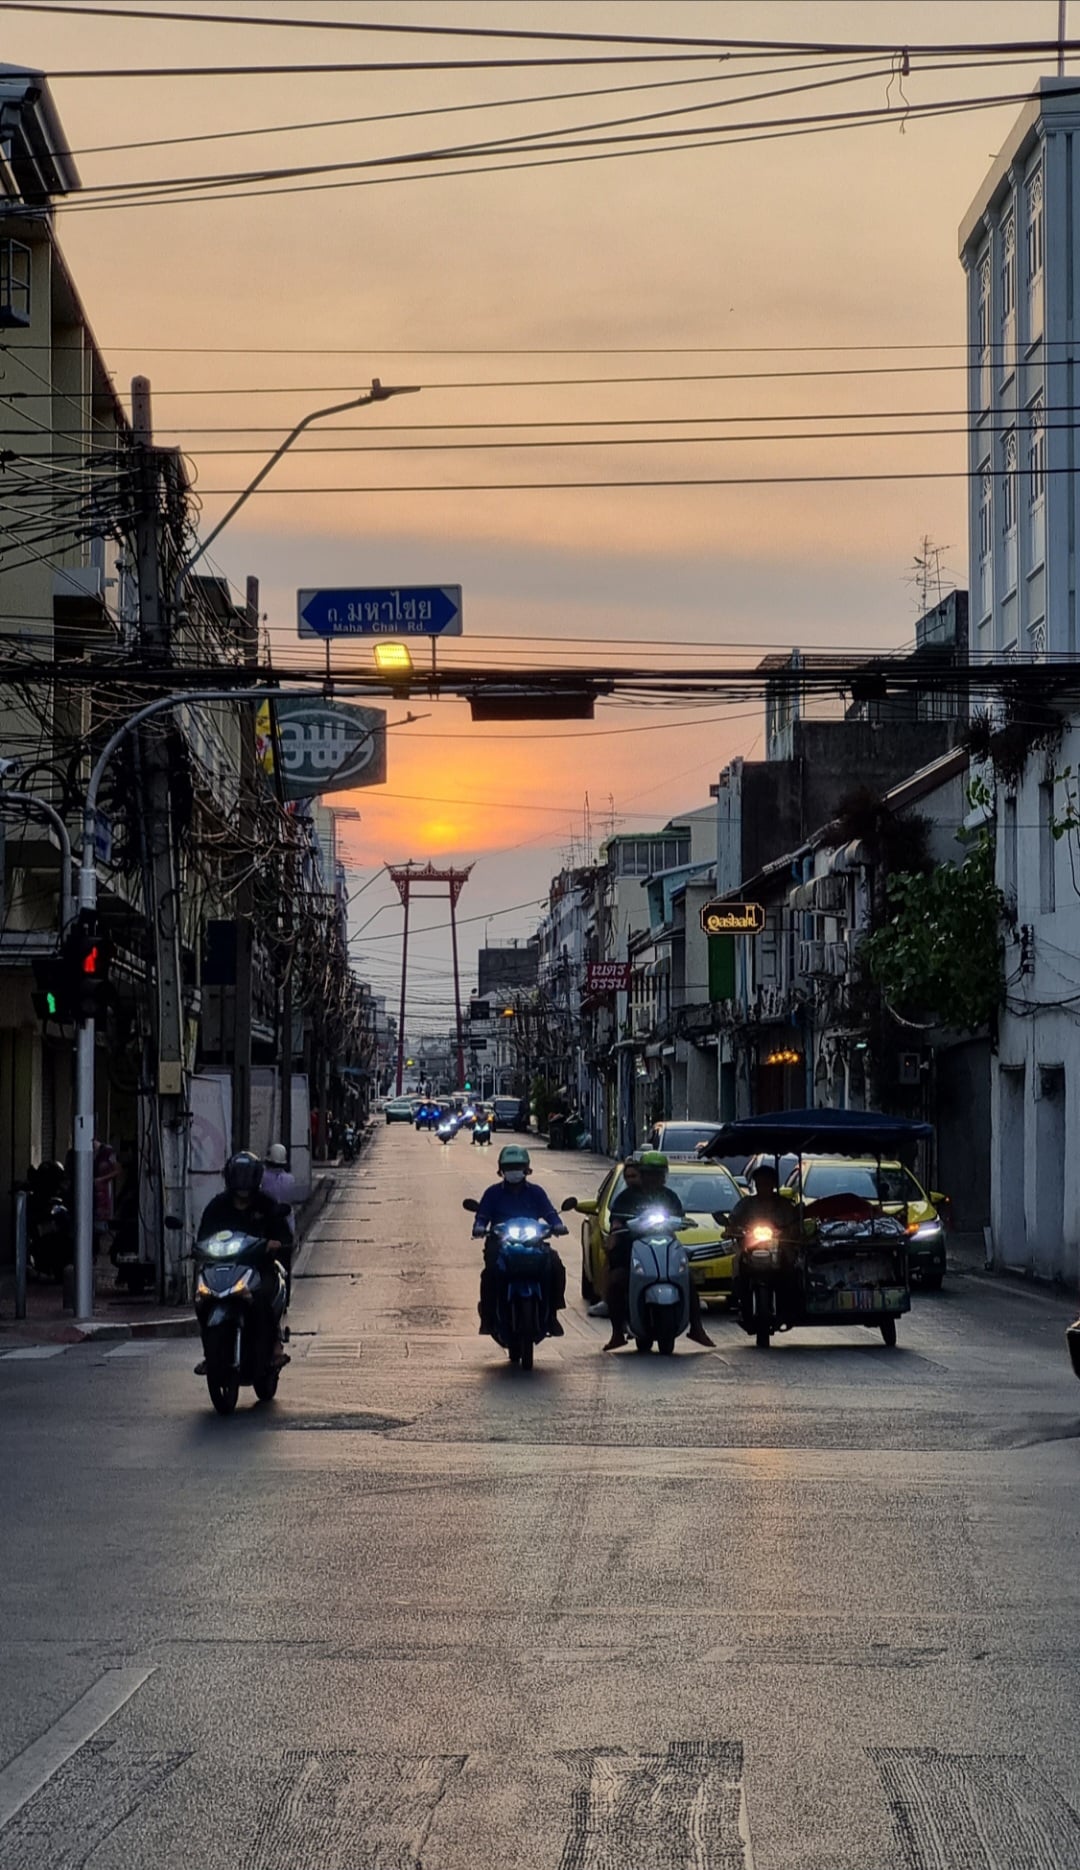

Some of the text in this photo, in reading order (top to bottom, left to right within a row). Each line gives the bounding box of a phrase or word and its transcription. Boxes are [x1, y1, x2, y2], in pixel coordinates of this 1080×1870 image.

[348, 591, 432, 622] มหาไชย
[333, 621, 427, 633] Maha Chai Rd.
[590, 977, 627, 990] ธรรม
